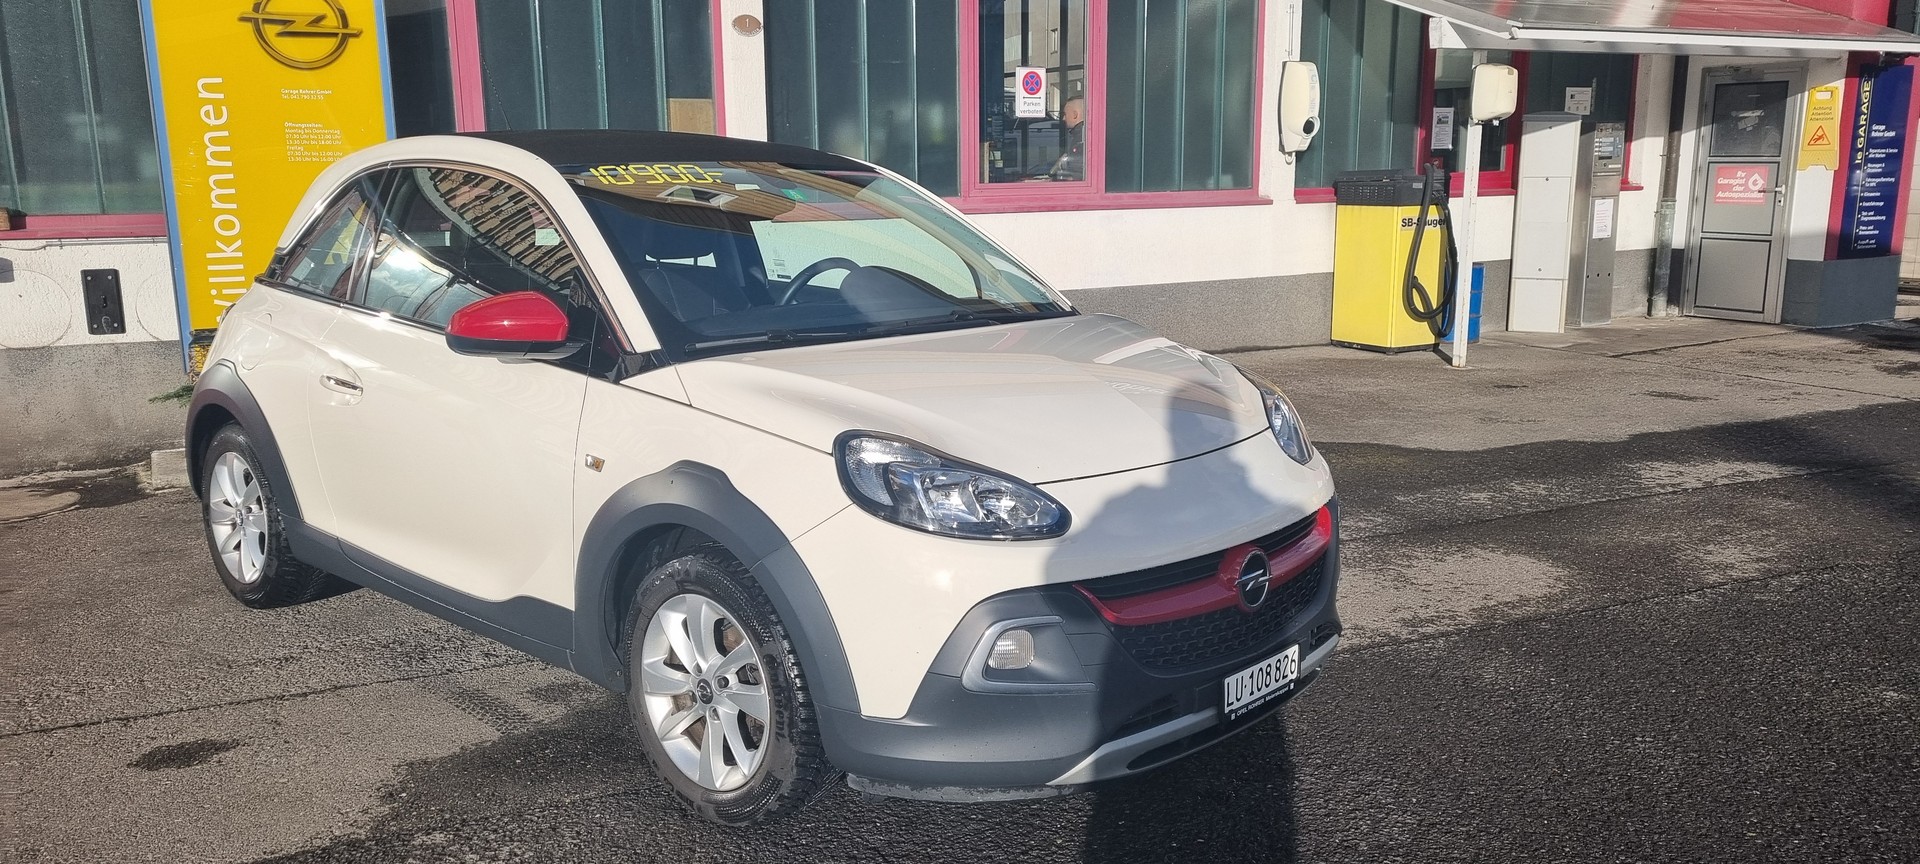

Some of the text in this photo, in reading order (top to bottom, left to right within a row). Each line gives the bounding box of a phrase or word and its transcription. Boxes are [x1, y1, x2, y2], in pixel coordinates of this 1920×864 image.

[1855, 80, 1871, 164] le GARAGE
[196, 77, 248, 322] illkommen
[1718, 178, 1746, 186] Garagist
[1401, 216, 1446, 228] SB-Suger
